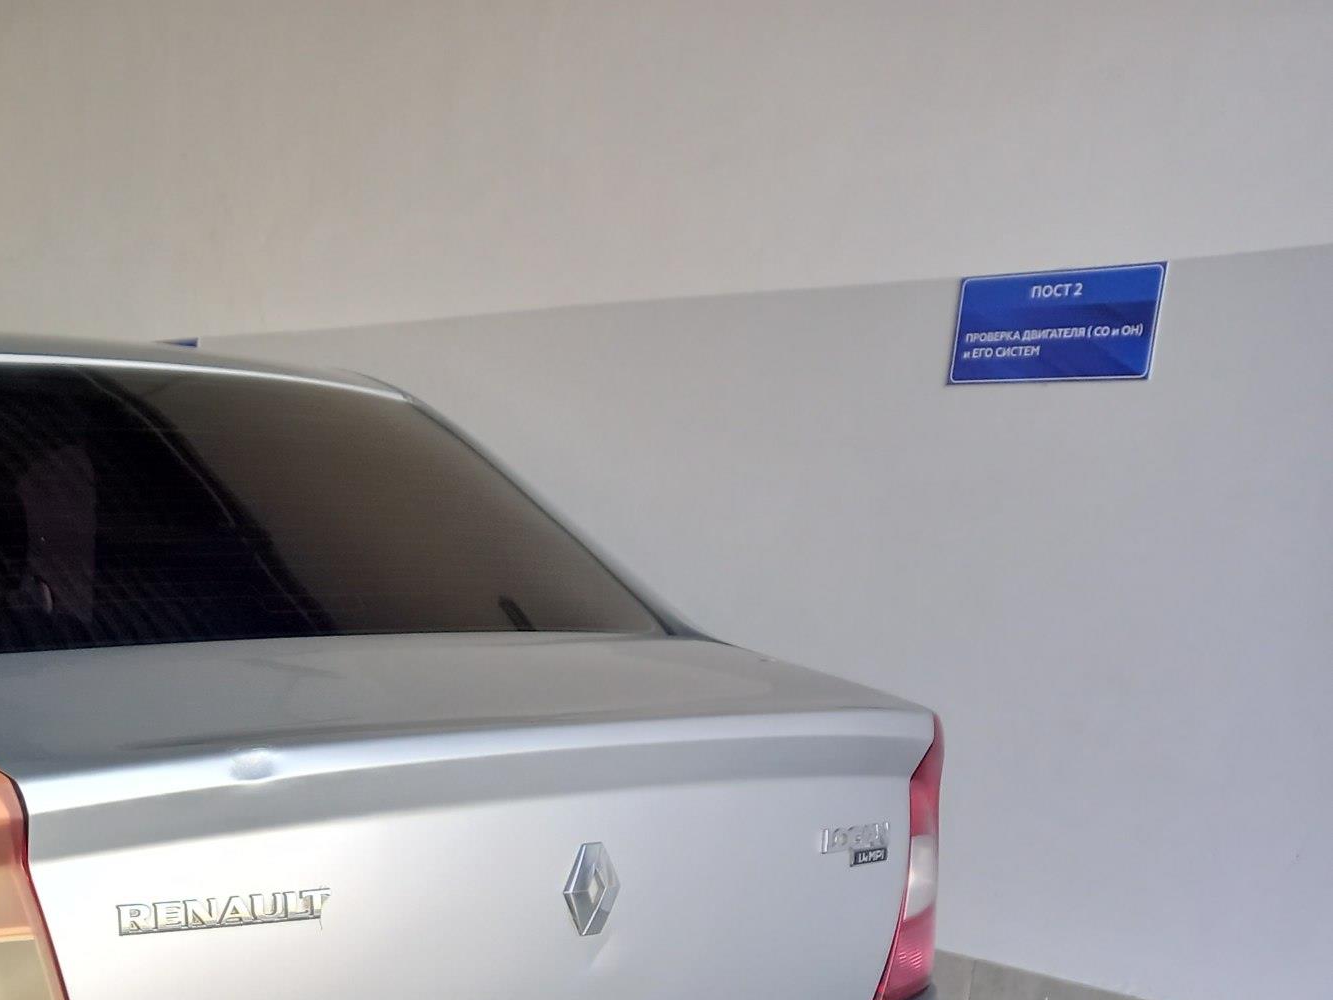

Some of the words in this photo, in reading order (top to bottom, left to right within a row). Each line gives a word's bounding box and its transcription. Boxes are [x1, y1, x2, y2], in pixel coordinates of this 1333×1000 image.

[1030, 284, 1071, 298] ПОСТ
[1074, 283, 1083, 296] 2
[966, 330, 1021, 342] ПРОВЕРКА
[1022, 326, 1086, 341] ДВИГАТЕЛЯ
[972, 348, 993, 358] ЕГО
[995, 346, 1040, 358] СИСТЕМ
[117, 887, 330, 936] RENAULT
